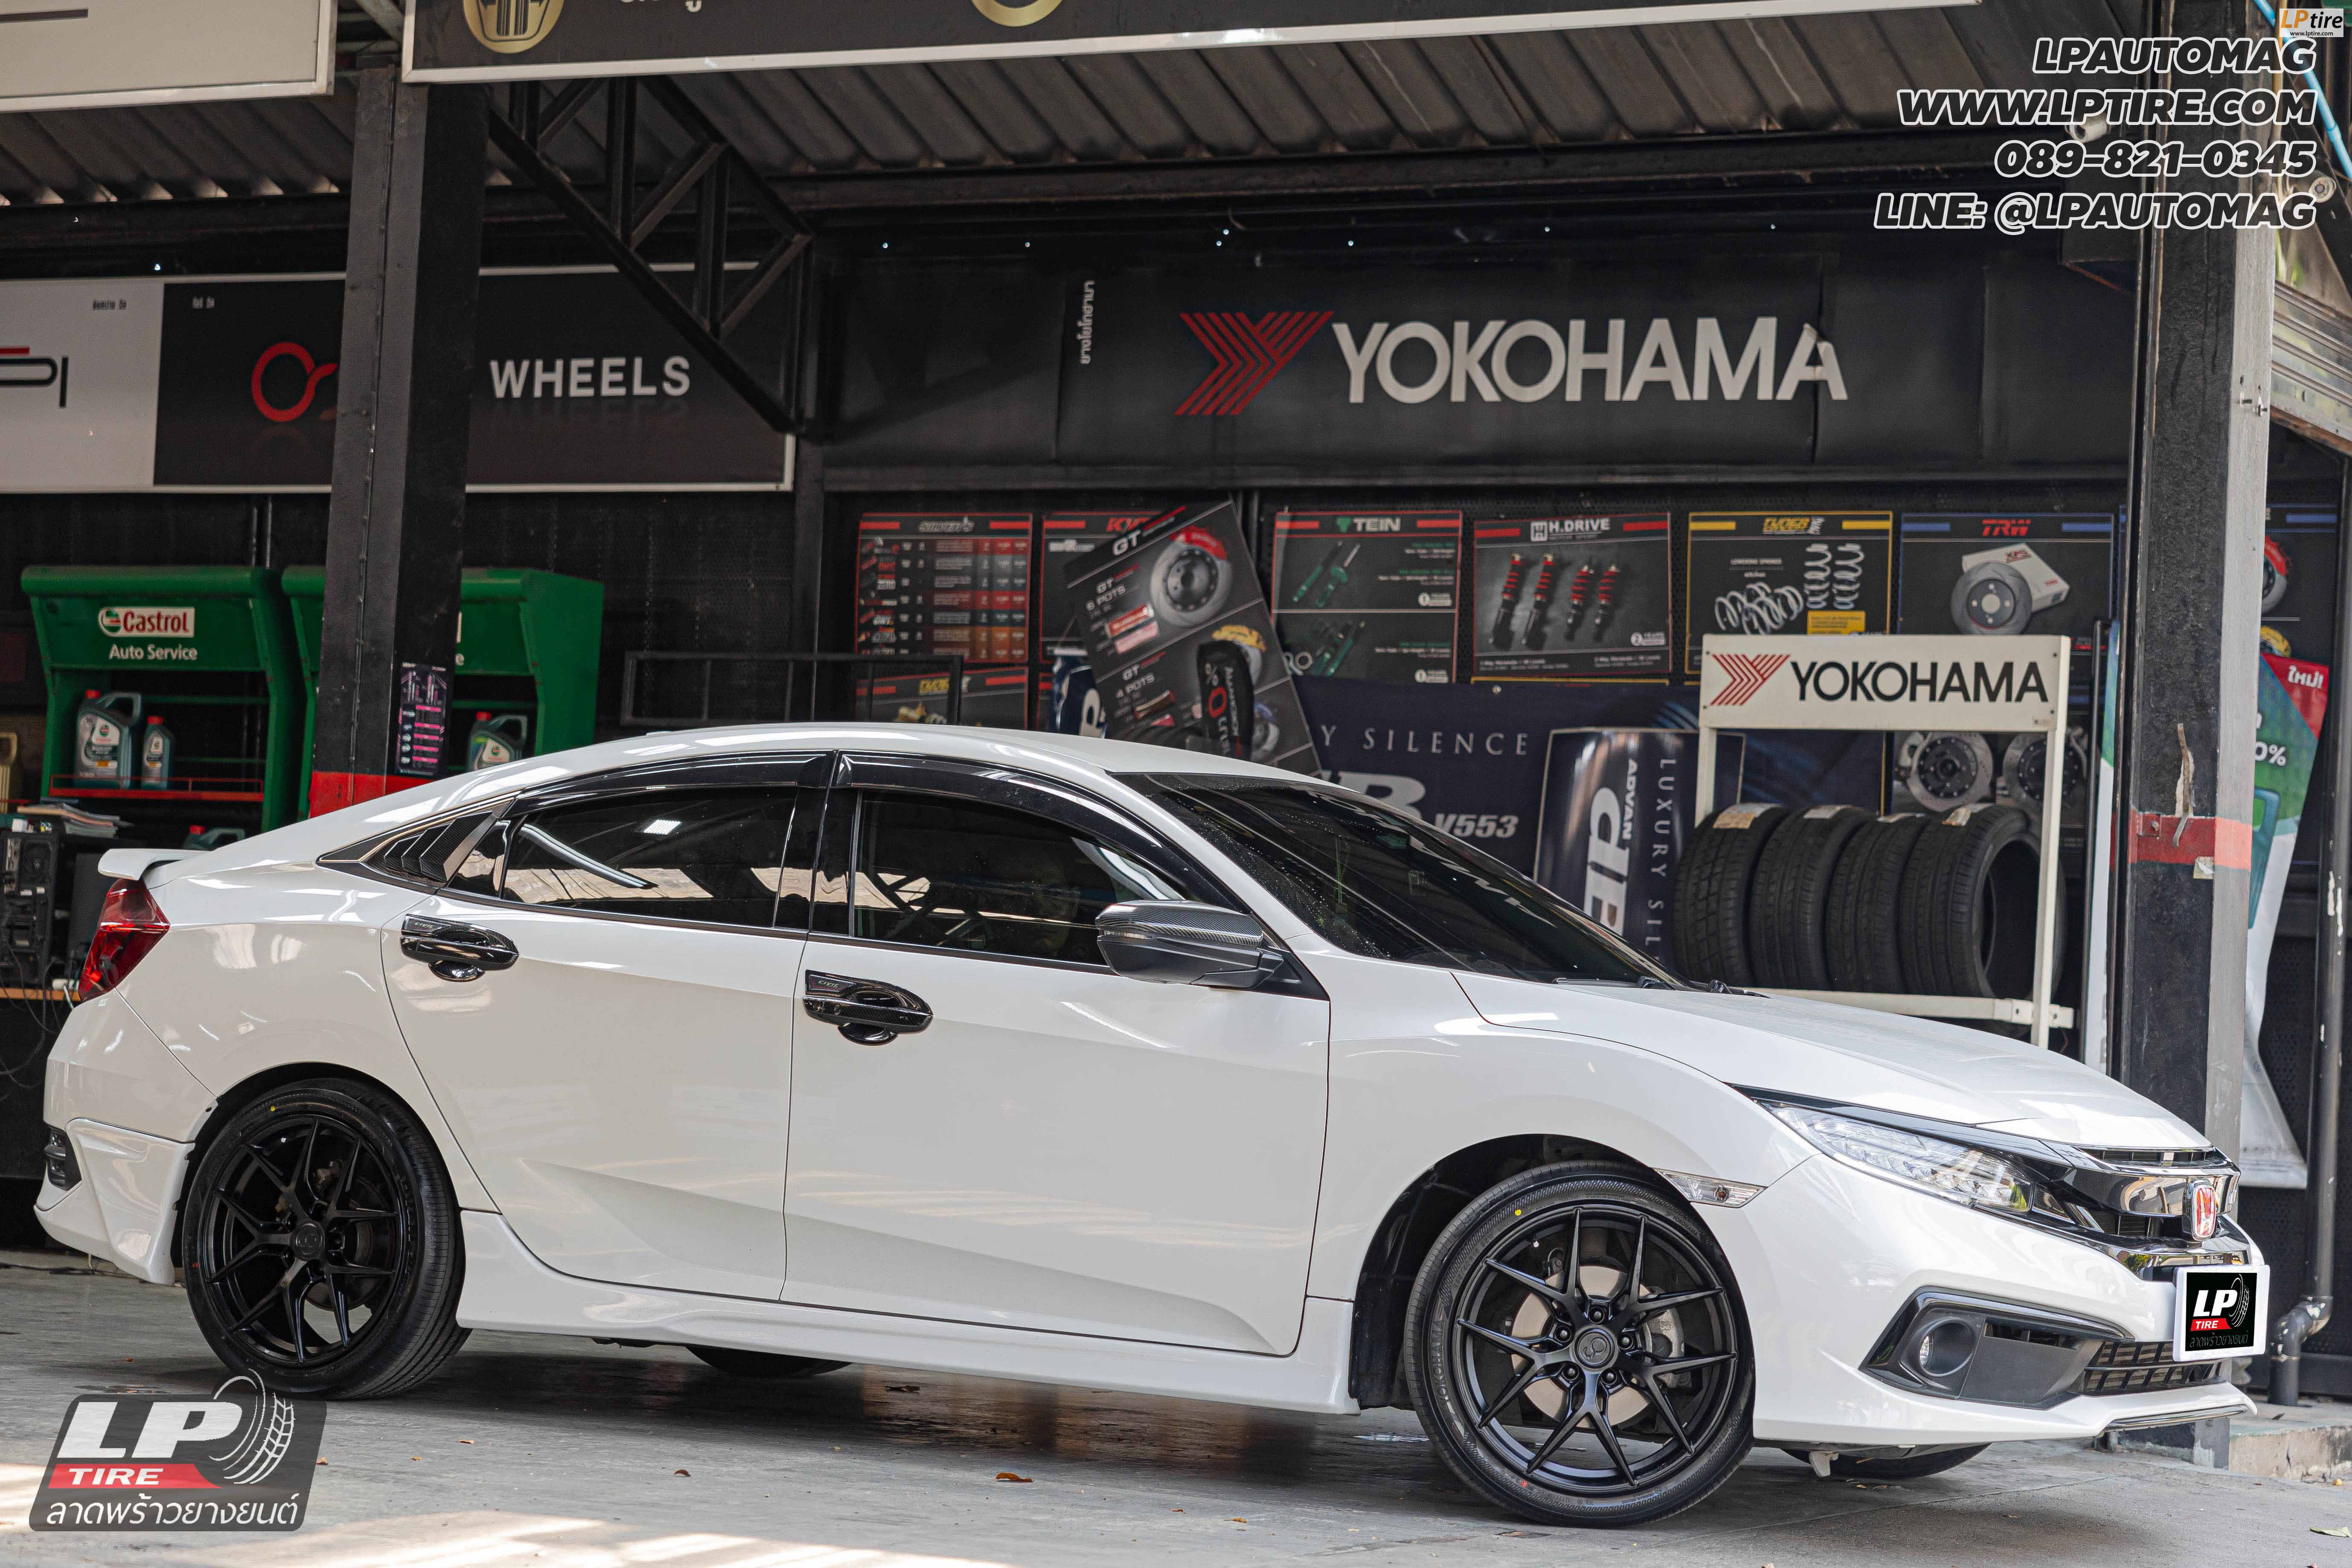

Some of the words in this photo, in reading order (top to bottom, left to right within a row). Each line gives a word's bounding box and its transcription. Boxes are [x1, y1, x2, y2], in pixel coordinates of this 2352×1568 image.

[1332, 316, 1848, 404] YOKOHAMA
[490, 355, 690, 399] WHEELS
[1353, 517, 1401, 532] TEIN
[1549, 517, 1611, 534] H.DRIVE
[1112, 529, 1141, 556] GT
[123, 610, 189, 634] Castrol
[109, 644, 144, 660] Auto
[147, 644, 198, 661] Service
[1791, 661, 2048, 703] YOKOHAMA
[1362, 727, 1529, 756] SILENCE
[1622, 758, 1638, 841] ADVAN
[1434, 813, 1519, 839] V553
[1650, 758, 1677, 877] LUXURY
[817, 980, 840, 988] CIVIC
